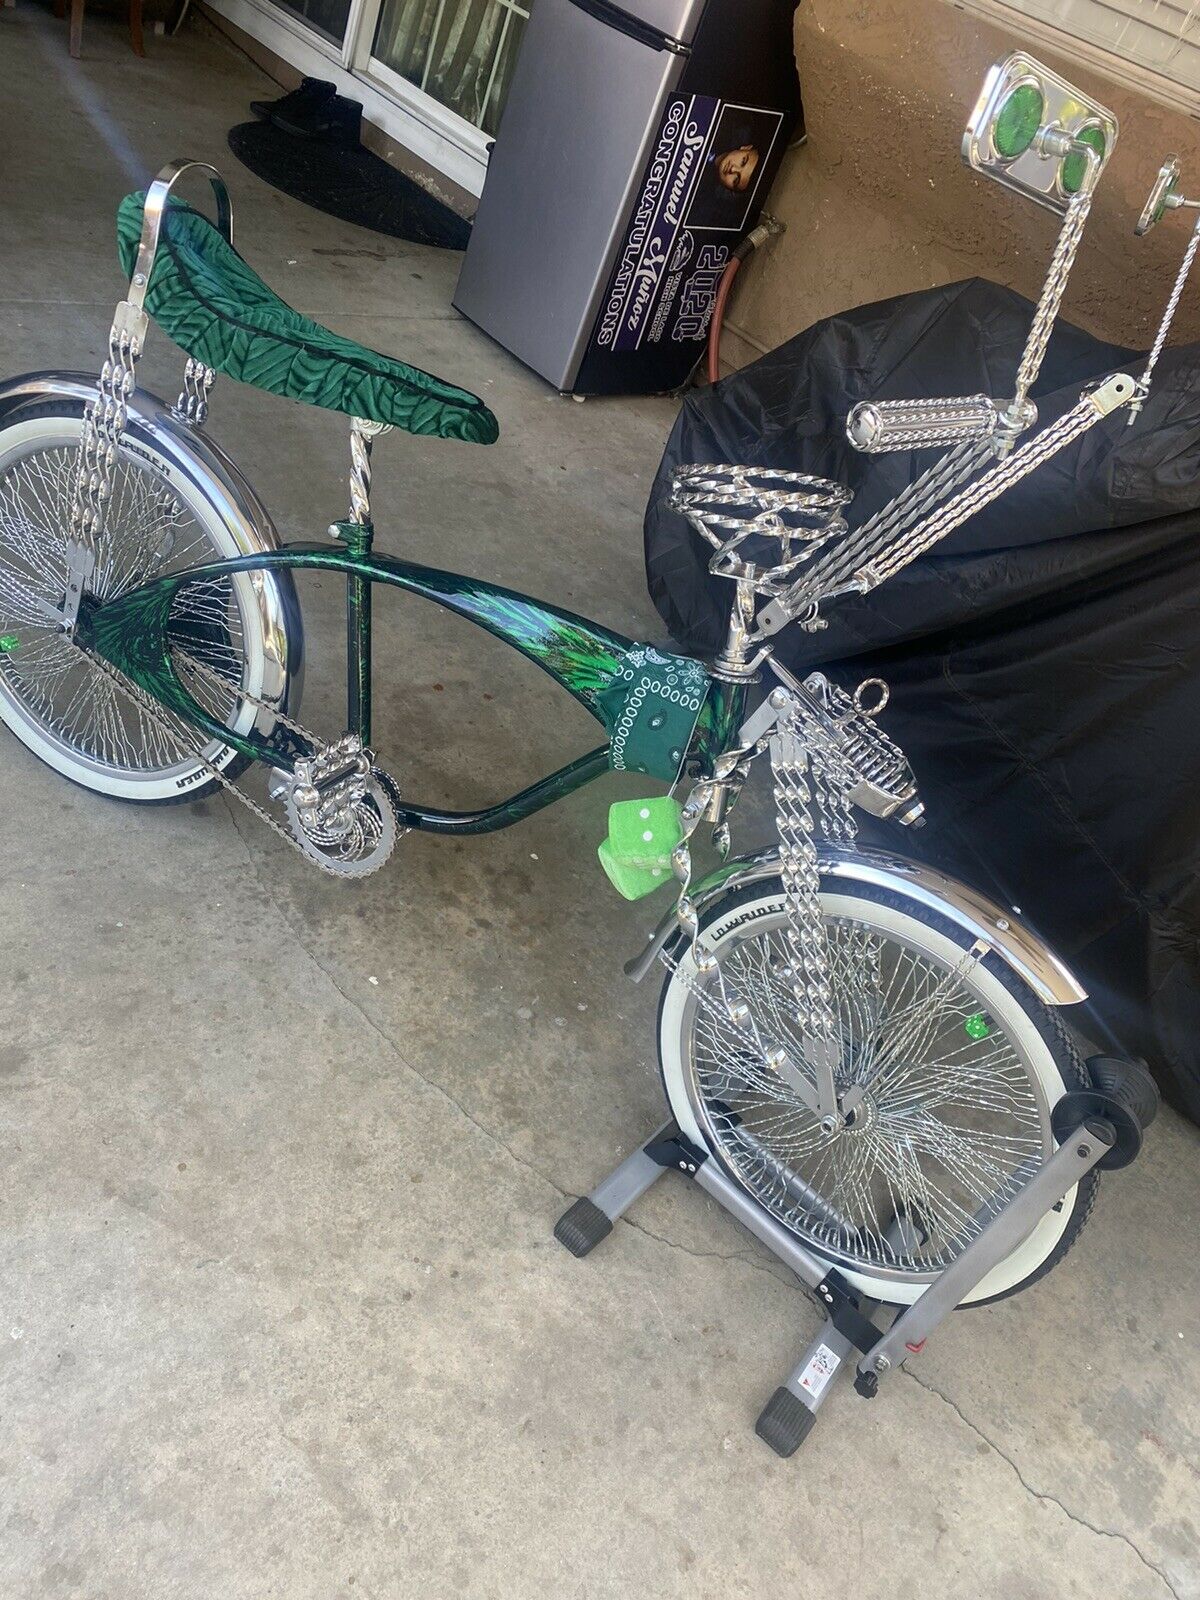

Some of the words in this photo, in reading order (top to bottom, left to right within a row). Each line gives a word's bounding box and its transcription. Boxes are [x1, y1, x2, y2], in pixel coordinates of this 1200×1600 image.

[597, 101, 686, 345] CONGRATULATIONS
[663, 121, 704, 226] Samuel
[661, 275, 675, 302] HIGH
[671, 245, 729, 342] 2020
